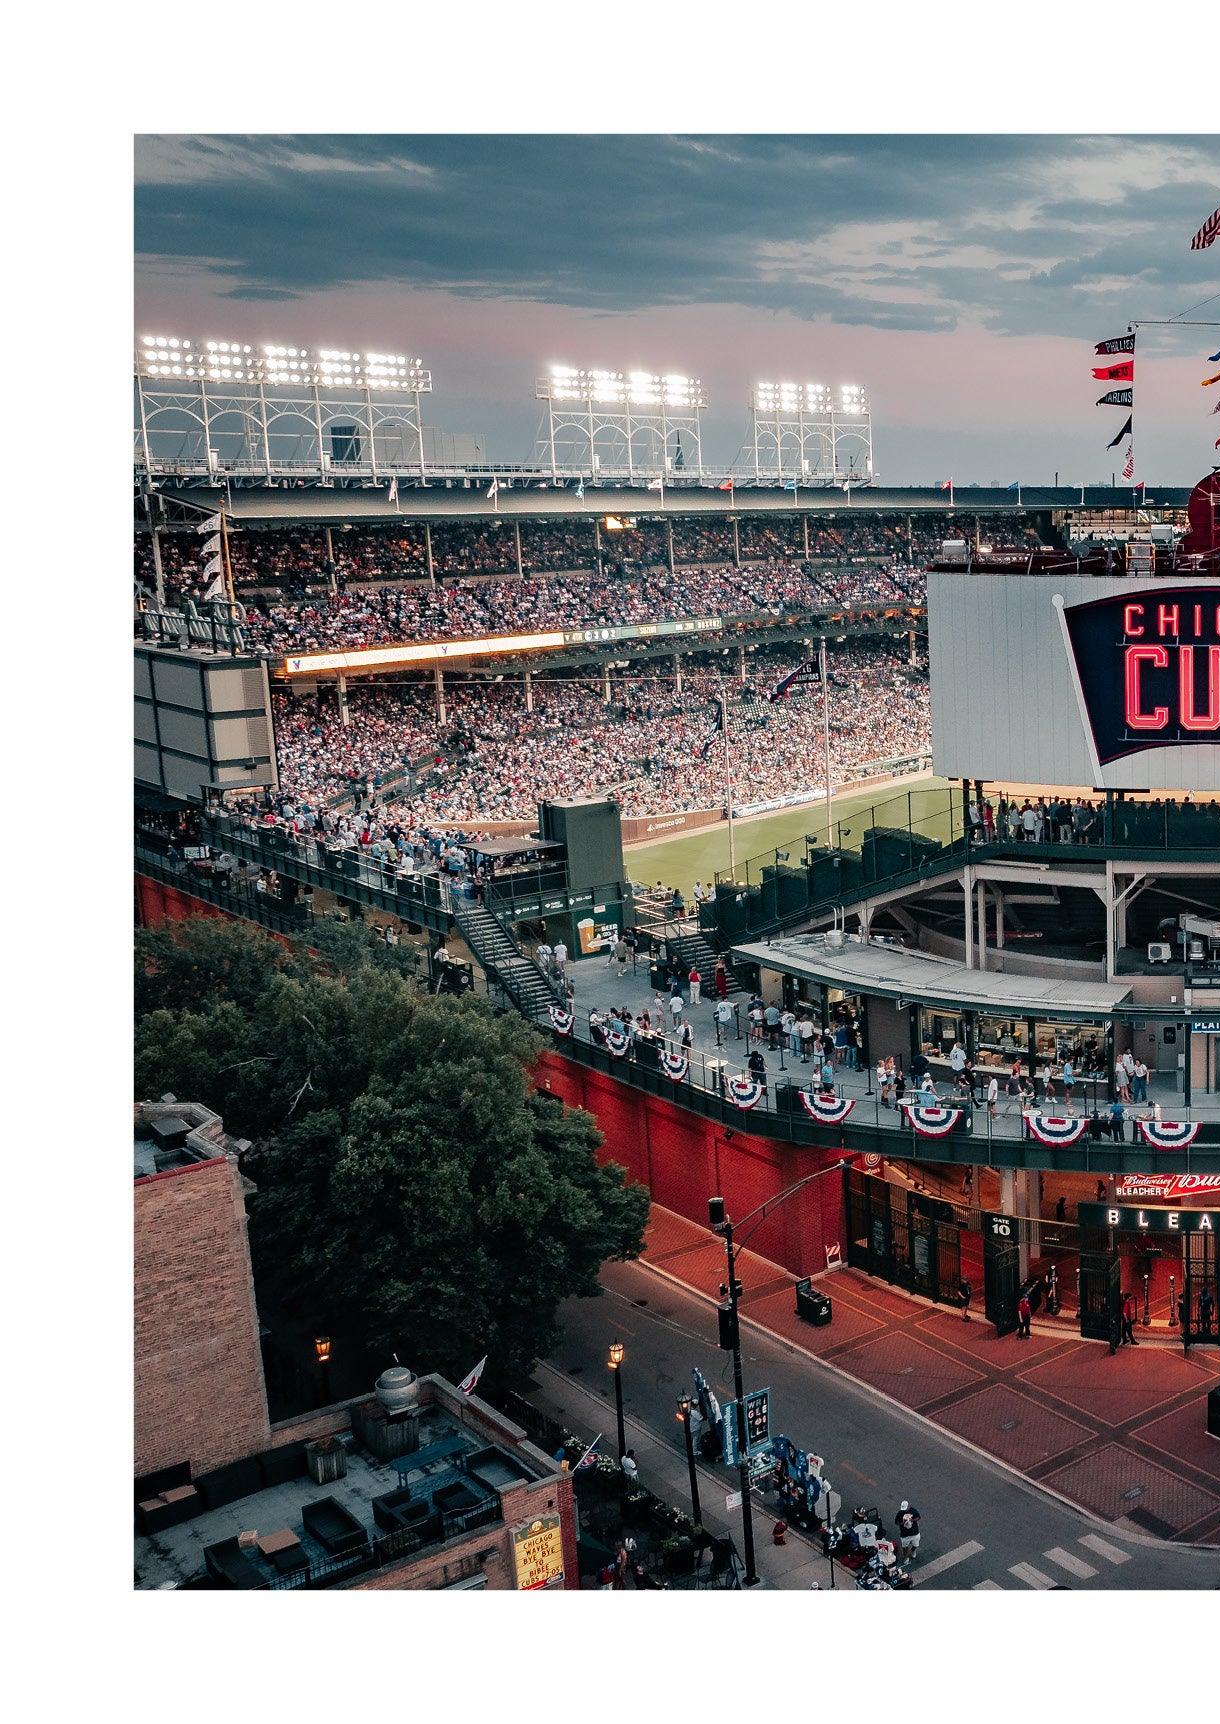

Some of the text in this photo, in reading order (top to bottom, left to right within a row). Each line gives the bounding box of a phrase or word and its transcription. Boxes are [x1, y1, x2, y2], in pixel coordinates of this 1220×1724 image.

[1105, 338, 1134, 353] PHILLIES
[1108, 366, 1129, 380] METS
[1116, 1187, 1162, 1196] BLEACHER
[992, 1217, 1010, 1225] GATE
[991, 1223, 1011, 1236] 10
[523, 1533, 553, 1549] CHICAGO
[526, 1542, 549, 1556] WAVES
[523, 1547, 555, 1565] BYE BYE
[534, 1559, 544, 1568] TO
[521, 1576, 540, 1588] CUBS
